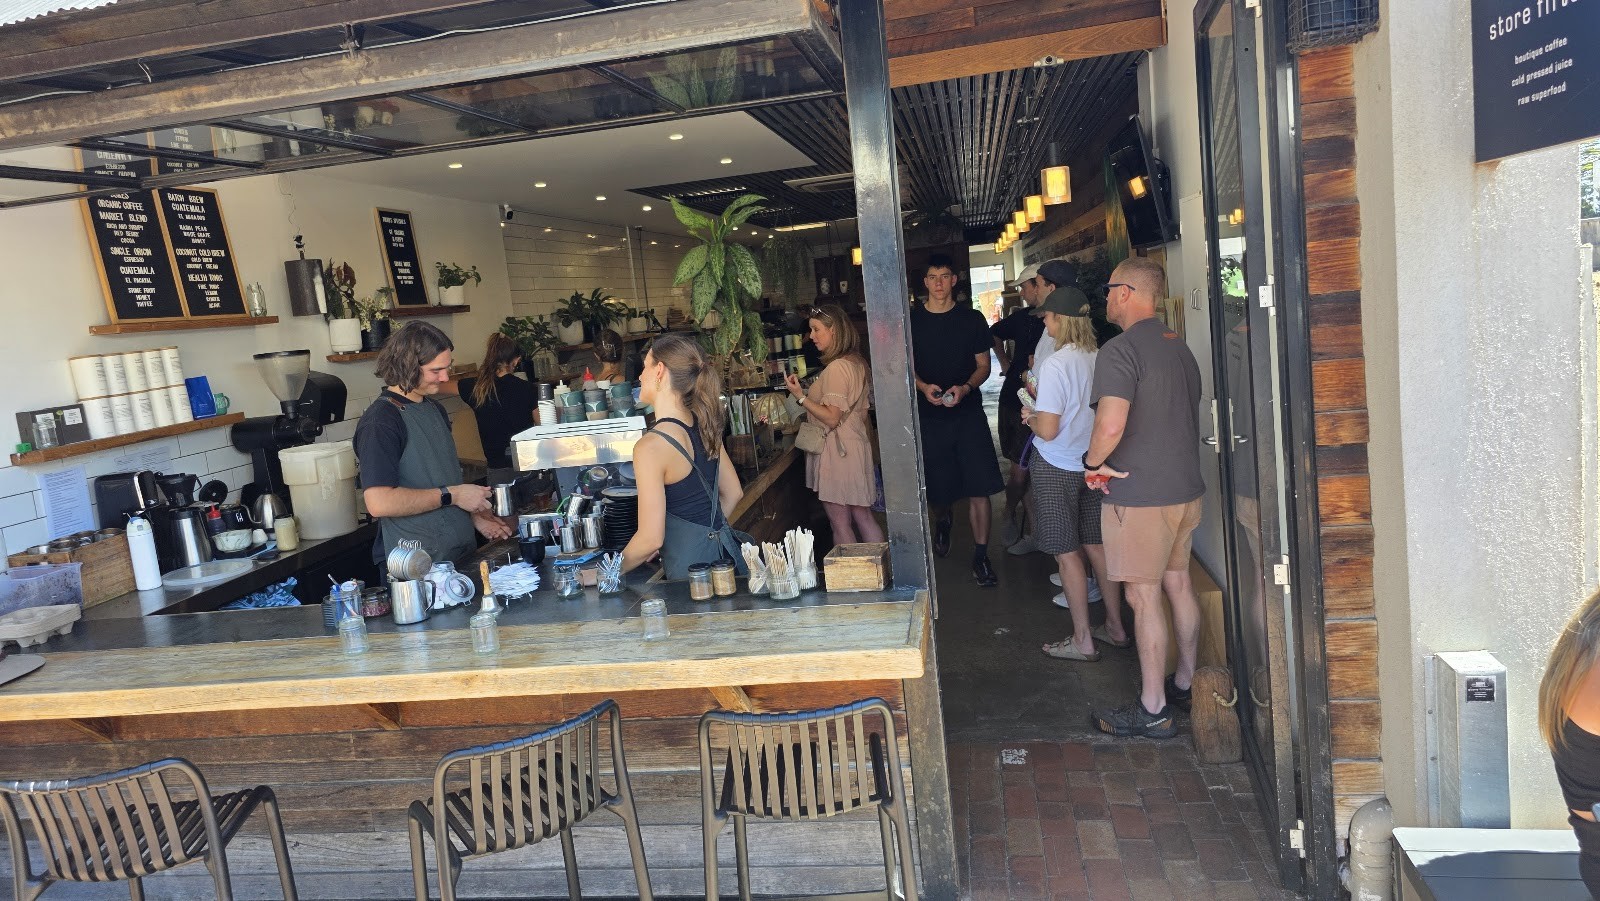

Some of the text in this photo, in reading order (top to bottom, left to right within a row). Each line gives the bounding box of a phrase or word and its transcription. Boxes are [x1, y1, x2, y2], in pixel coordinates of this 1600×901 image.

[1489, 7, 1531, 41] store
[1514, 37, 1568, 65] boutique coffee
[1511, 58, 1573, 87] cold pressed juice
[1517, 81, 1567, 106] raw superfood
[167, 192, 204, 204] BATCH BREW
[97, 199, 145, 211] ORGANIC COFFEE
[171, 202, 206, 213] GUATEMALA
[99, 211, 148, 223] MARKET BLEND
[110, 246, 153, 257] SINGLE ORIGIN
[198, 248, 211, 257] COLD
[211, 249, 225, 257] BREW
[119, 266, 156, 275] GUATEMALA
[188, 273, 224, 282] HEALTH TONIC
